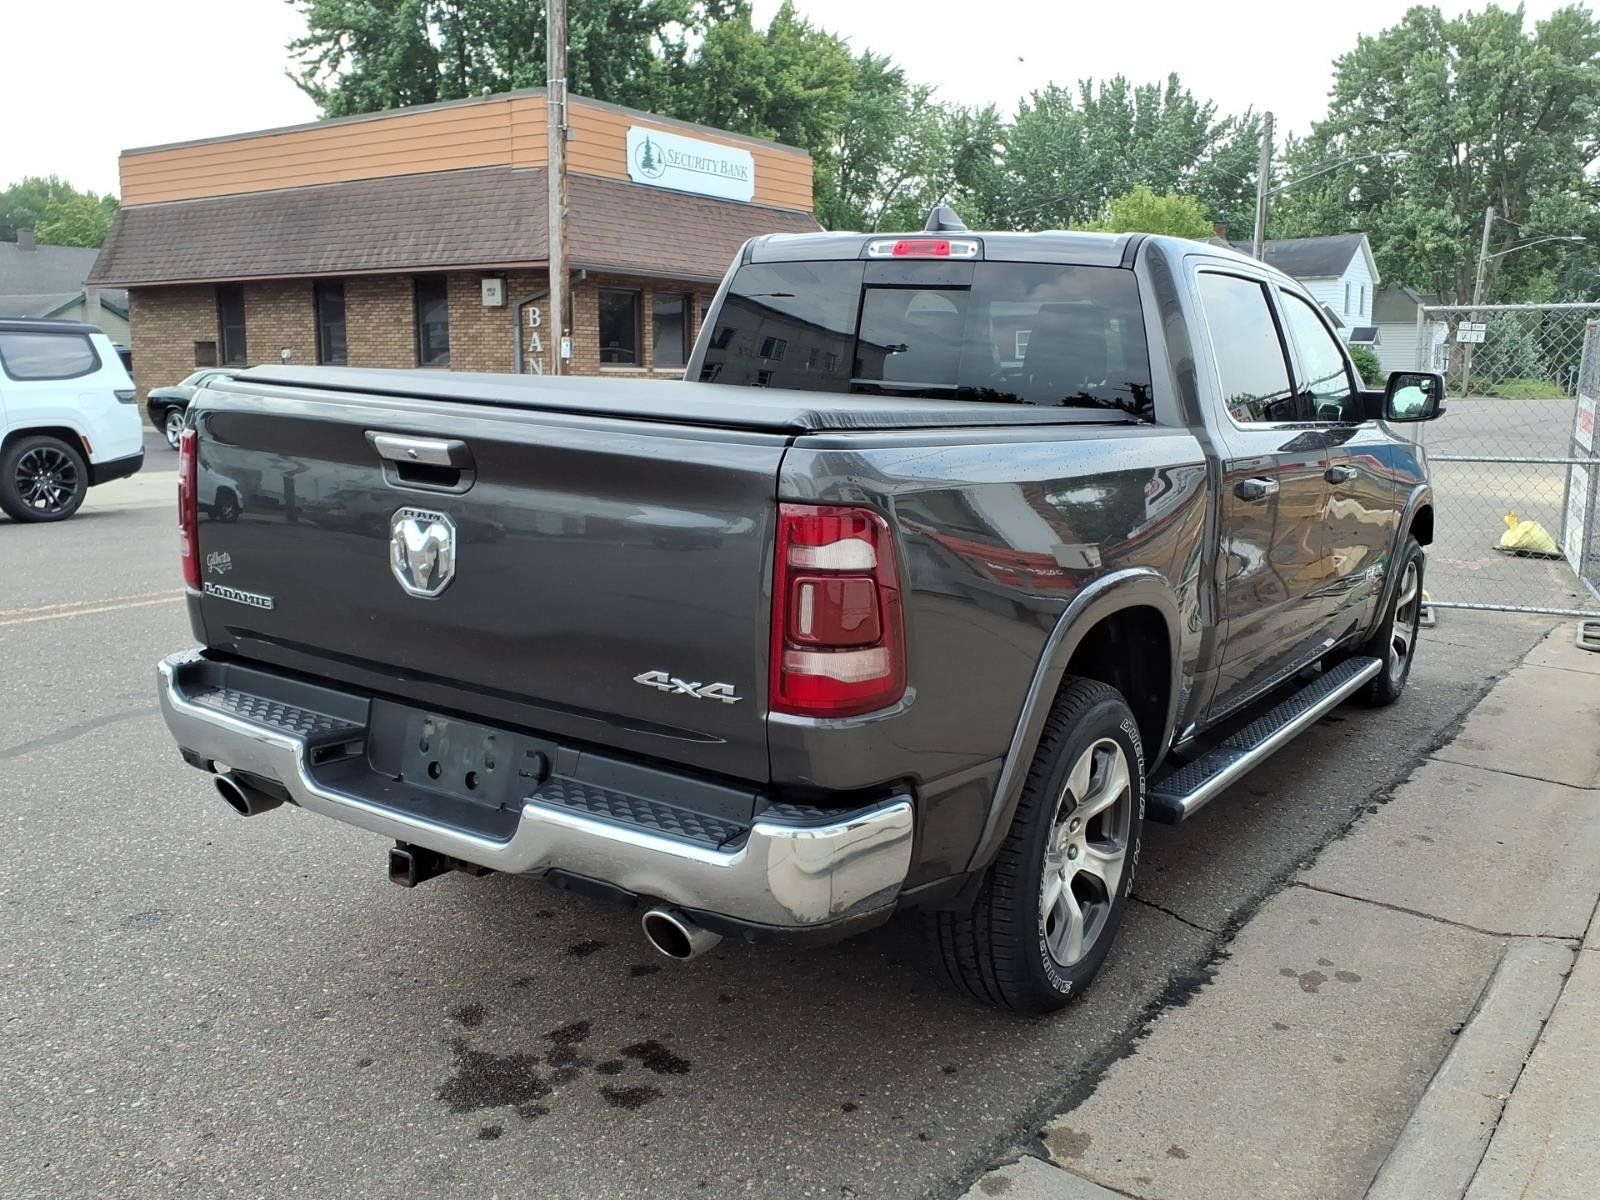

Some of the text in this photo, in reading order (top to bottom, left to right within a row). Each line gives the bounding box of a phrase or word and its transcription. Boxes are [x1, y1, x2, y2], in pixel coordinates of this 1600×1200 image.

[667, 149, 748, 178] SECURITY BANK
[403, 510, 441, 521] RAM
[204, 582, 274, 610] LARAMIE
